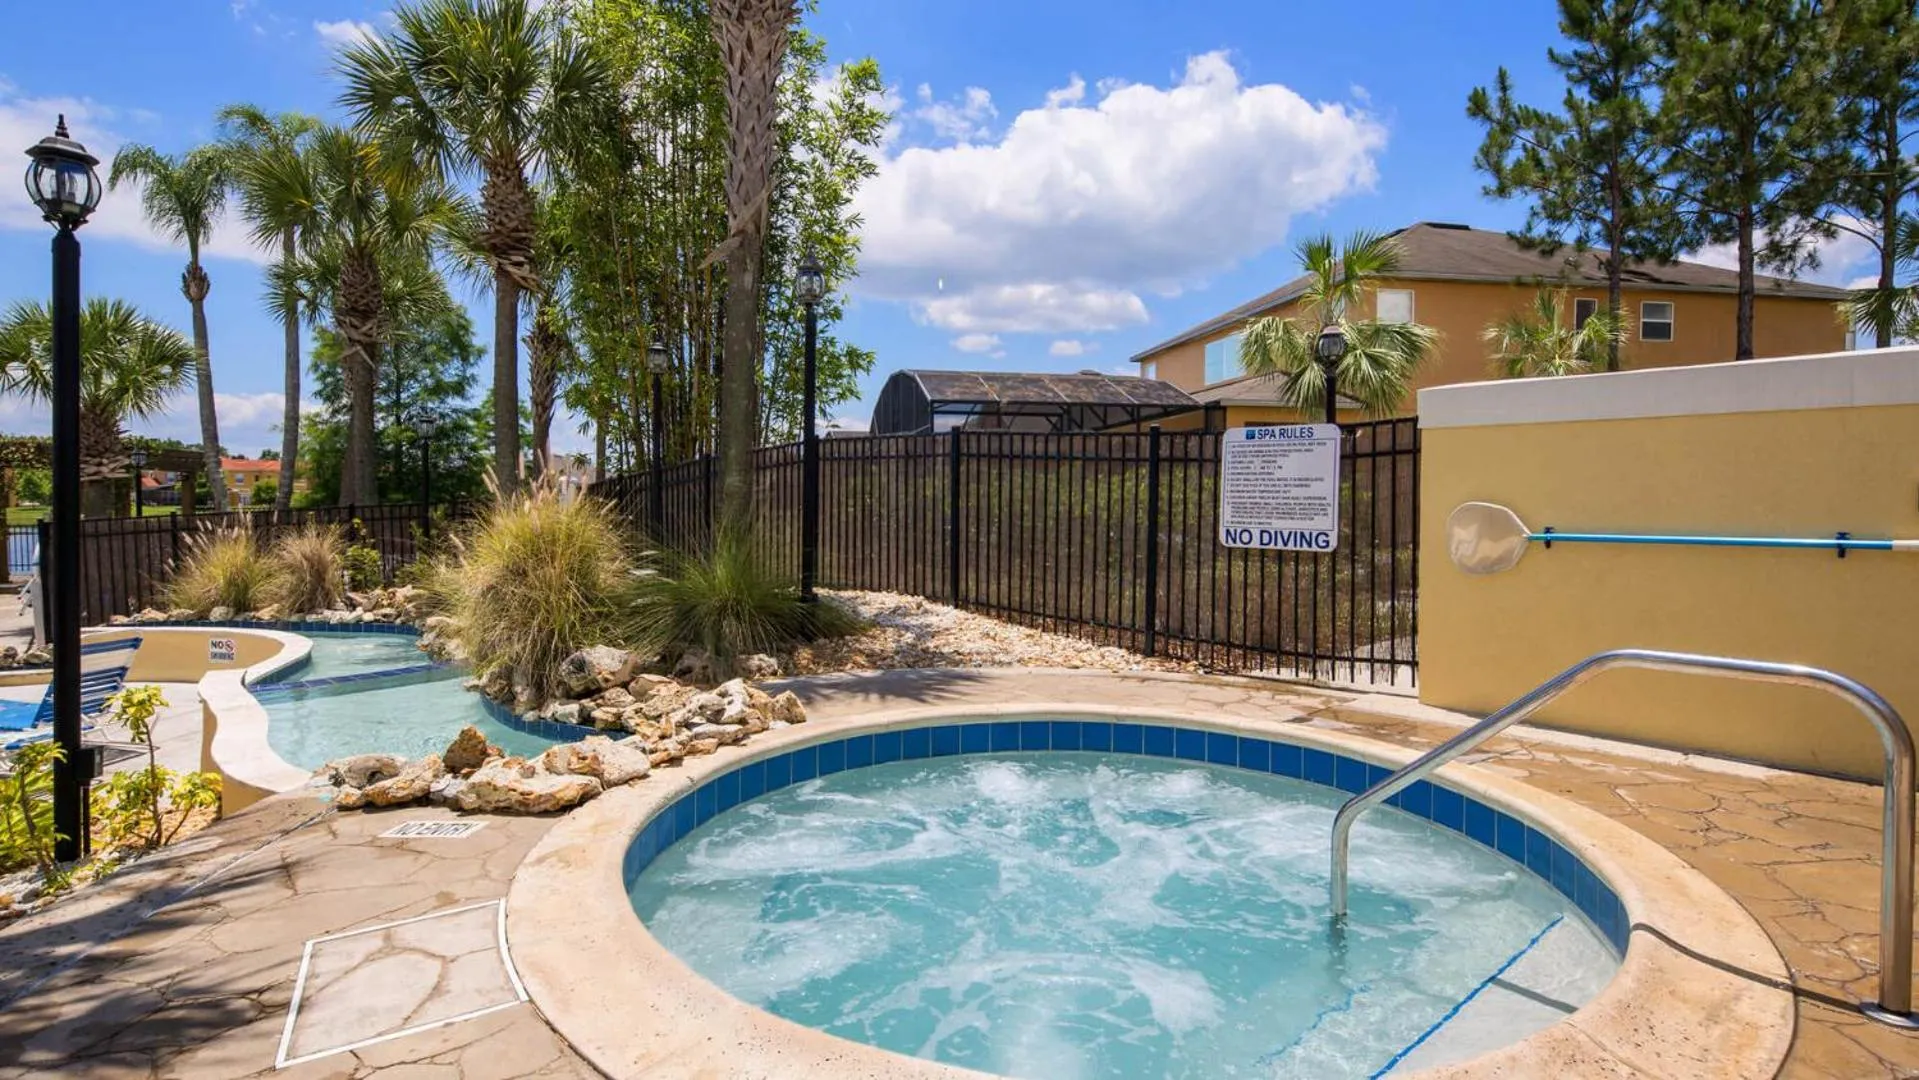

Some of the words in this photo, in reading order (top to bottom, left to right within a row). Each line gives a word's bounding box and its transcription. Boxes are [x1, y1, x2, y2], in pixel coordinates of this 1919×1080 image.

[1257, 429, 1276, 439] SPA
[1279, 427, 1314, 439] RULES
[1225, 529, 1253, 545] NO
[1260, 530, 1330, 549] DIVING
[210, 640, 224, 649] NO
[389, 822, 424, 835] NO
[416, 822, 477, 835] ENTRY
